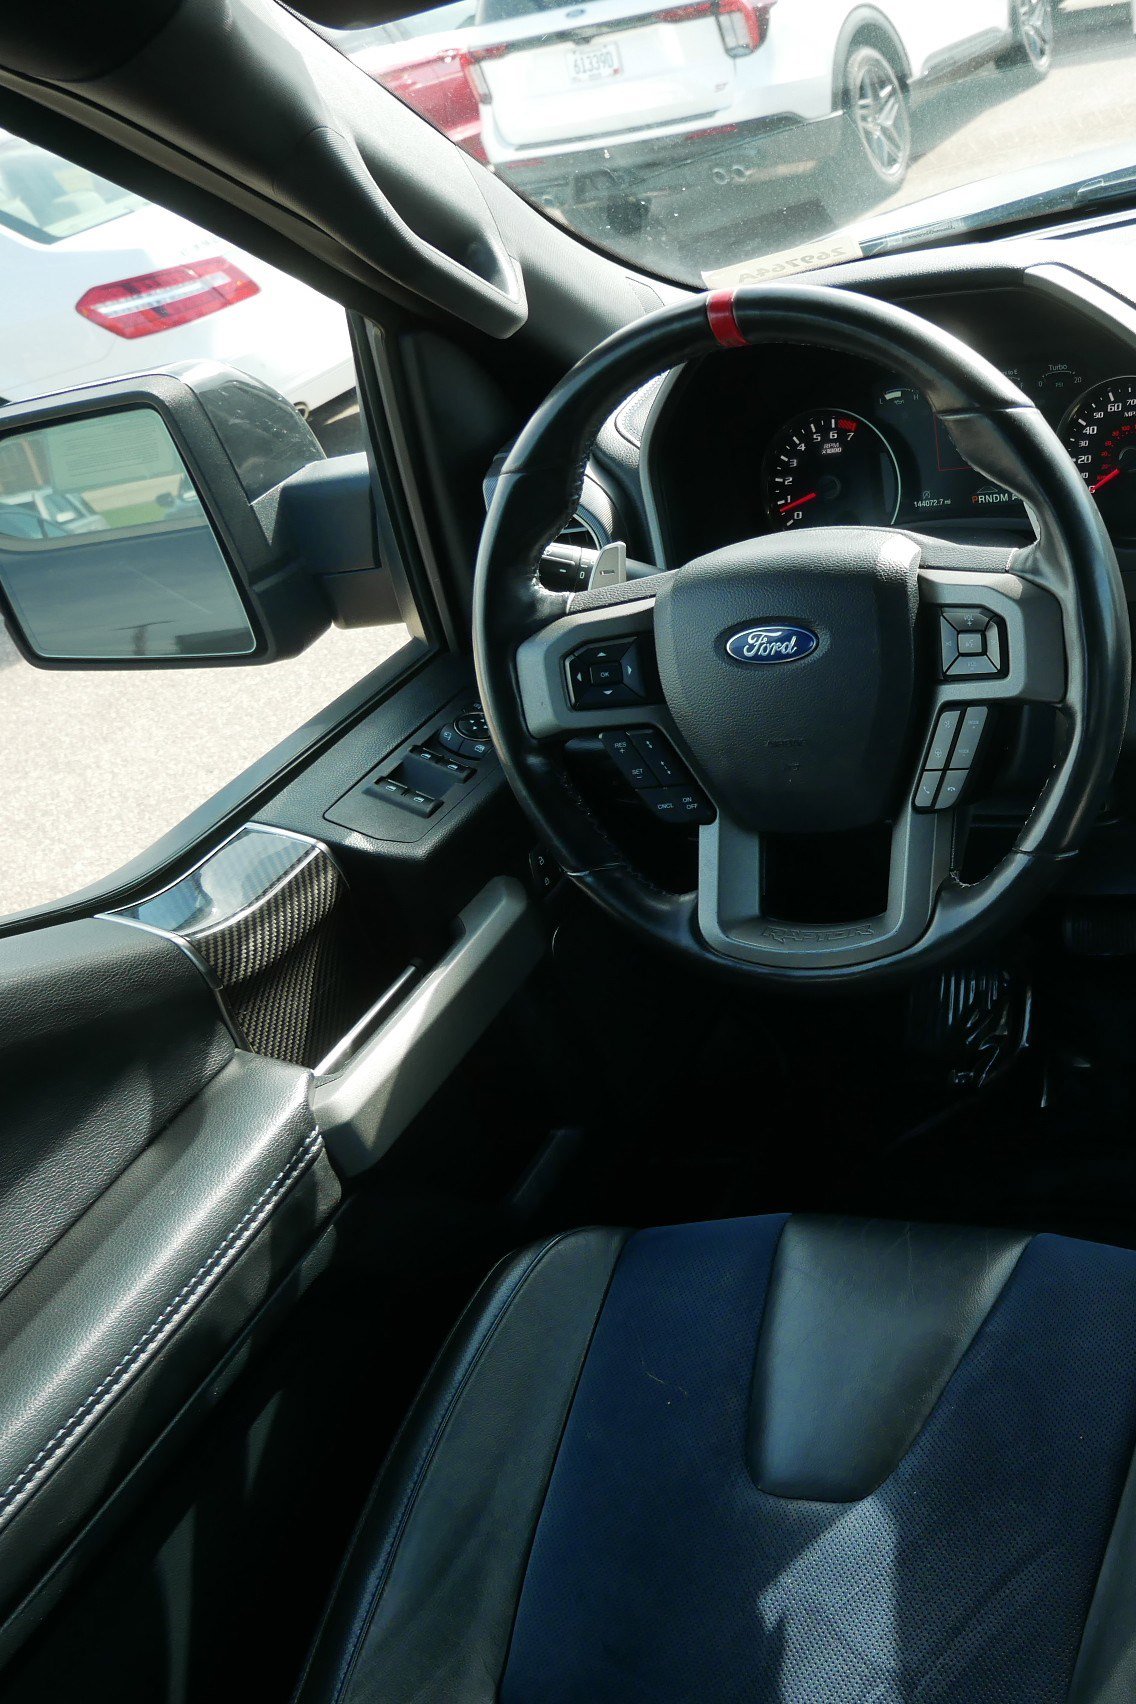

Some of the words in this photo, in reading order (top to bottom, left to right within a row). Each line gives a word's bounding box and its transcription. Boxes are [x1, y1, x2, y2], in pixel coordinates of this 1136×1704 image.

[1108, 403, 1122, 412] 60
[829, 431, 838, 439] 6
[1083, 426, 1097, 435] 40
[813, 434, 821, 442] 5
[847, 432, 854, 441] 7
[797, 443, 806, 451] 4
[789, 459, 797, 467] 3
[1077, 455, 1091, 464] 20
[785, 477, 793, 485] 2
[914, 498, 944, 508] 144072.7
[972, 493, 1009, 504] PRNDM
[794, 511, 803, 520] 0
[743, 631, 798, 657] Ford
